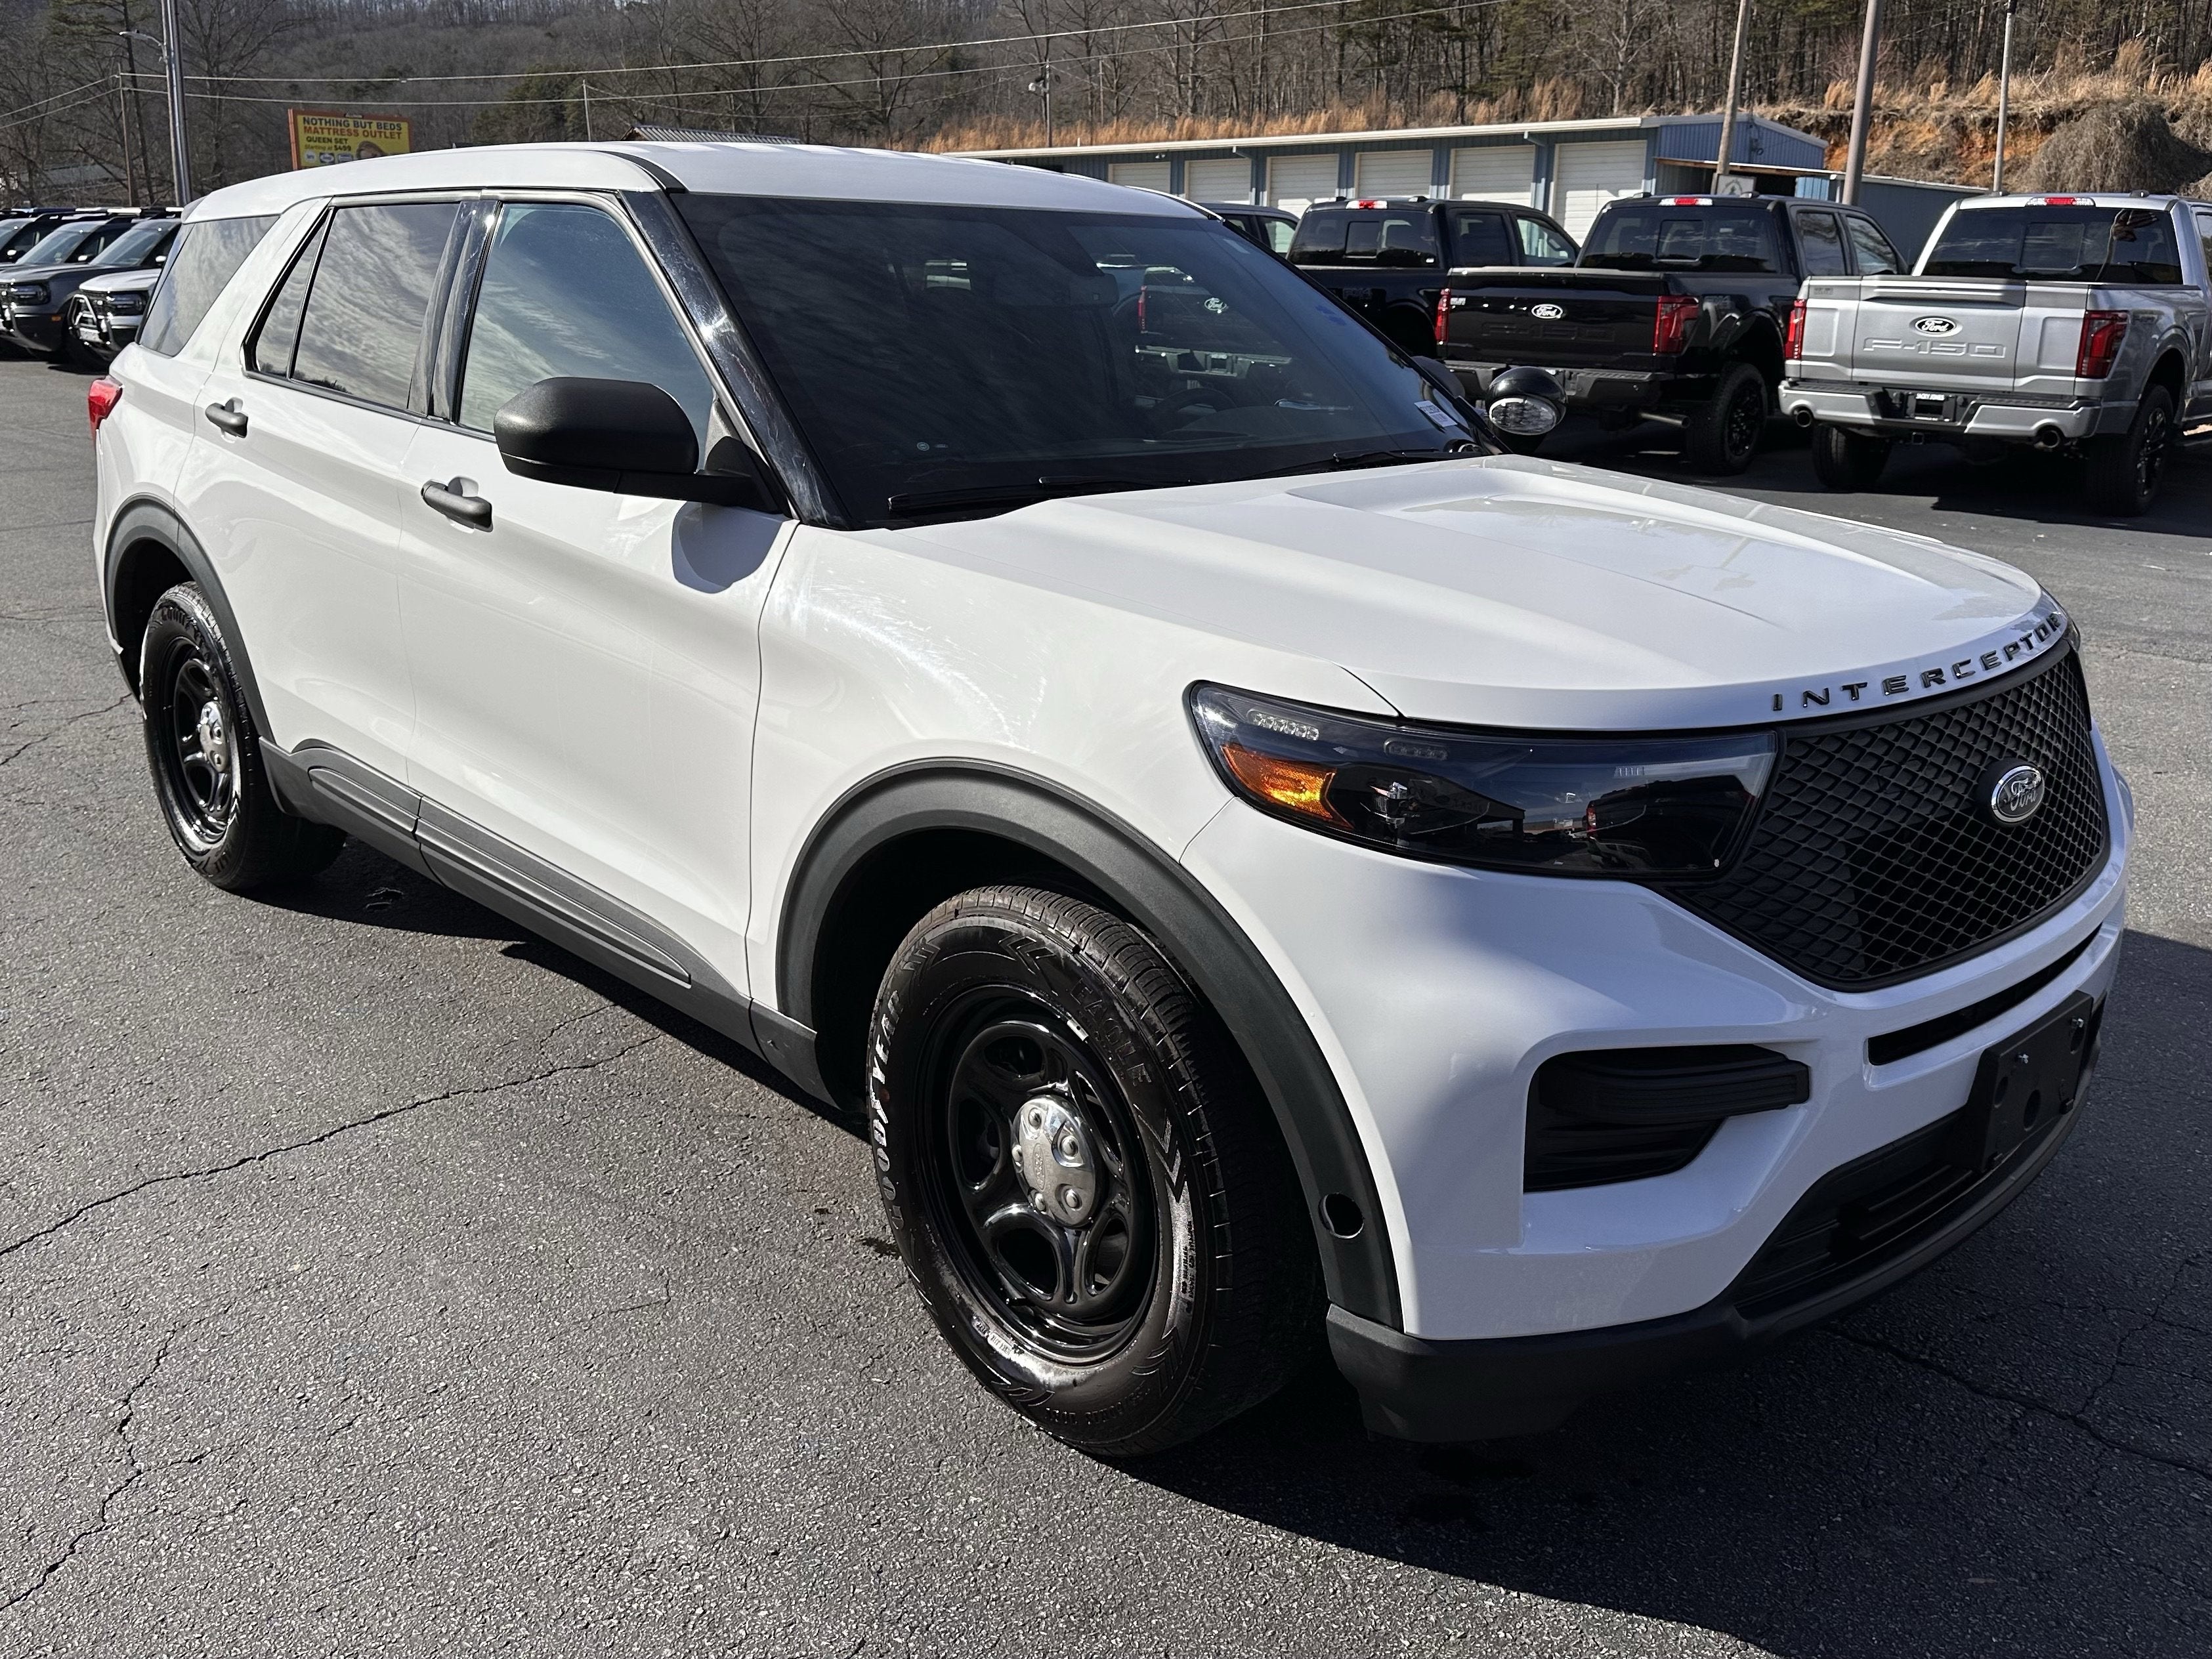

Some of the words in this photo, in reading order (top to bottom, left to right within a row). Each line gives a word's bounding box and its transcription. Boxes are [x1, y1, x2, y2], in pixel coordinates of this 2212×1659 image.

[303, 117, 350, 127] NOTHING
[353, 120, 373, 129] BUT
[376, 122, 402, 131] BEDS
[303, 126, 359, 137] MATTRESS
[362, 131, 402, 139] OUTLET
[1863, 337, 2006, 358] F-150
[1773, 612, 2062, 711] INTERCEPTOR
[1070, 977, 1152, 1086] EAGLE
[870, 990, 904, 1230] GOODYEAR
